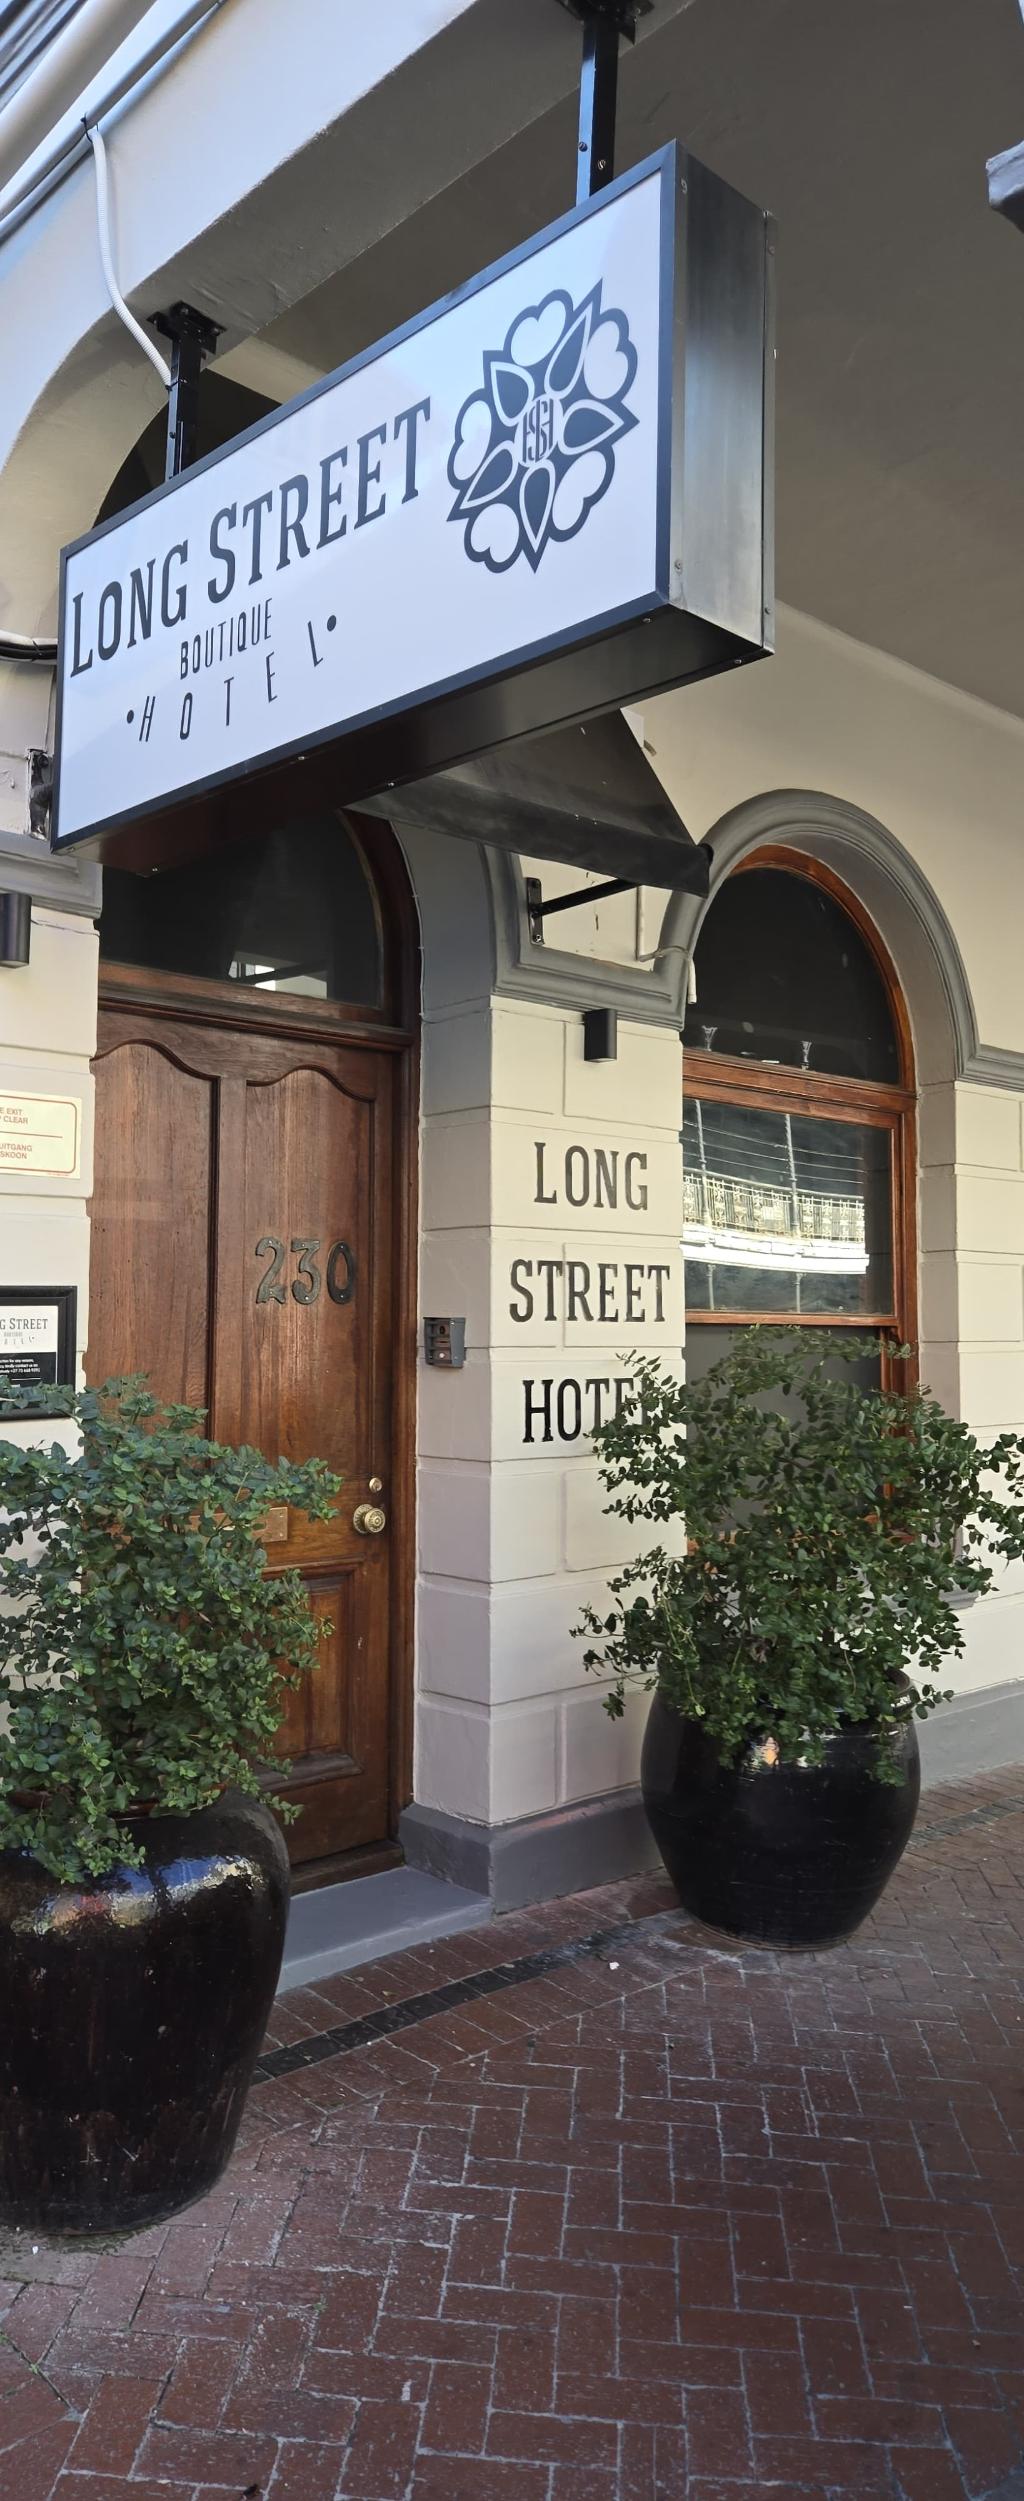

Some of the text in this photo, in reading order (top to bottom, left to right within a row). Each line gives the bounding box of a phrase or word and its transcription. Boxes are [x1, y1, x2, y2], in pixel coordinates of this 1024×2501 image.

[70, 396, 431, 678] LONG STREET
[180, 598, 273, 680] BOUTIQUE
[3, 1115, 29, 1124] CLEAR
[7, 1107, 23, 1116] EXIT
[533, 1141, 648, 1211] LONG
[255, 1236, 355, 1305] 230
[509, 1258, 671, 1323] STREET
[9, 1317, 49, 1330] STREET
